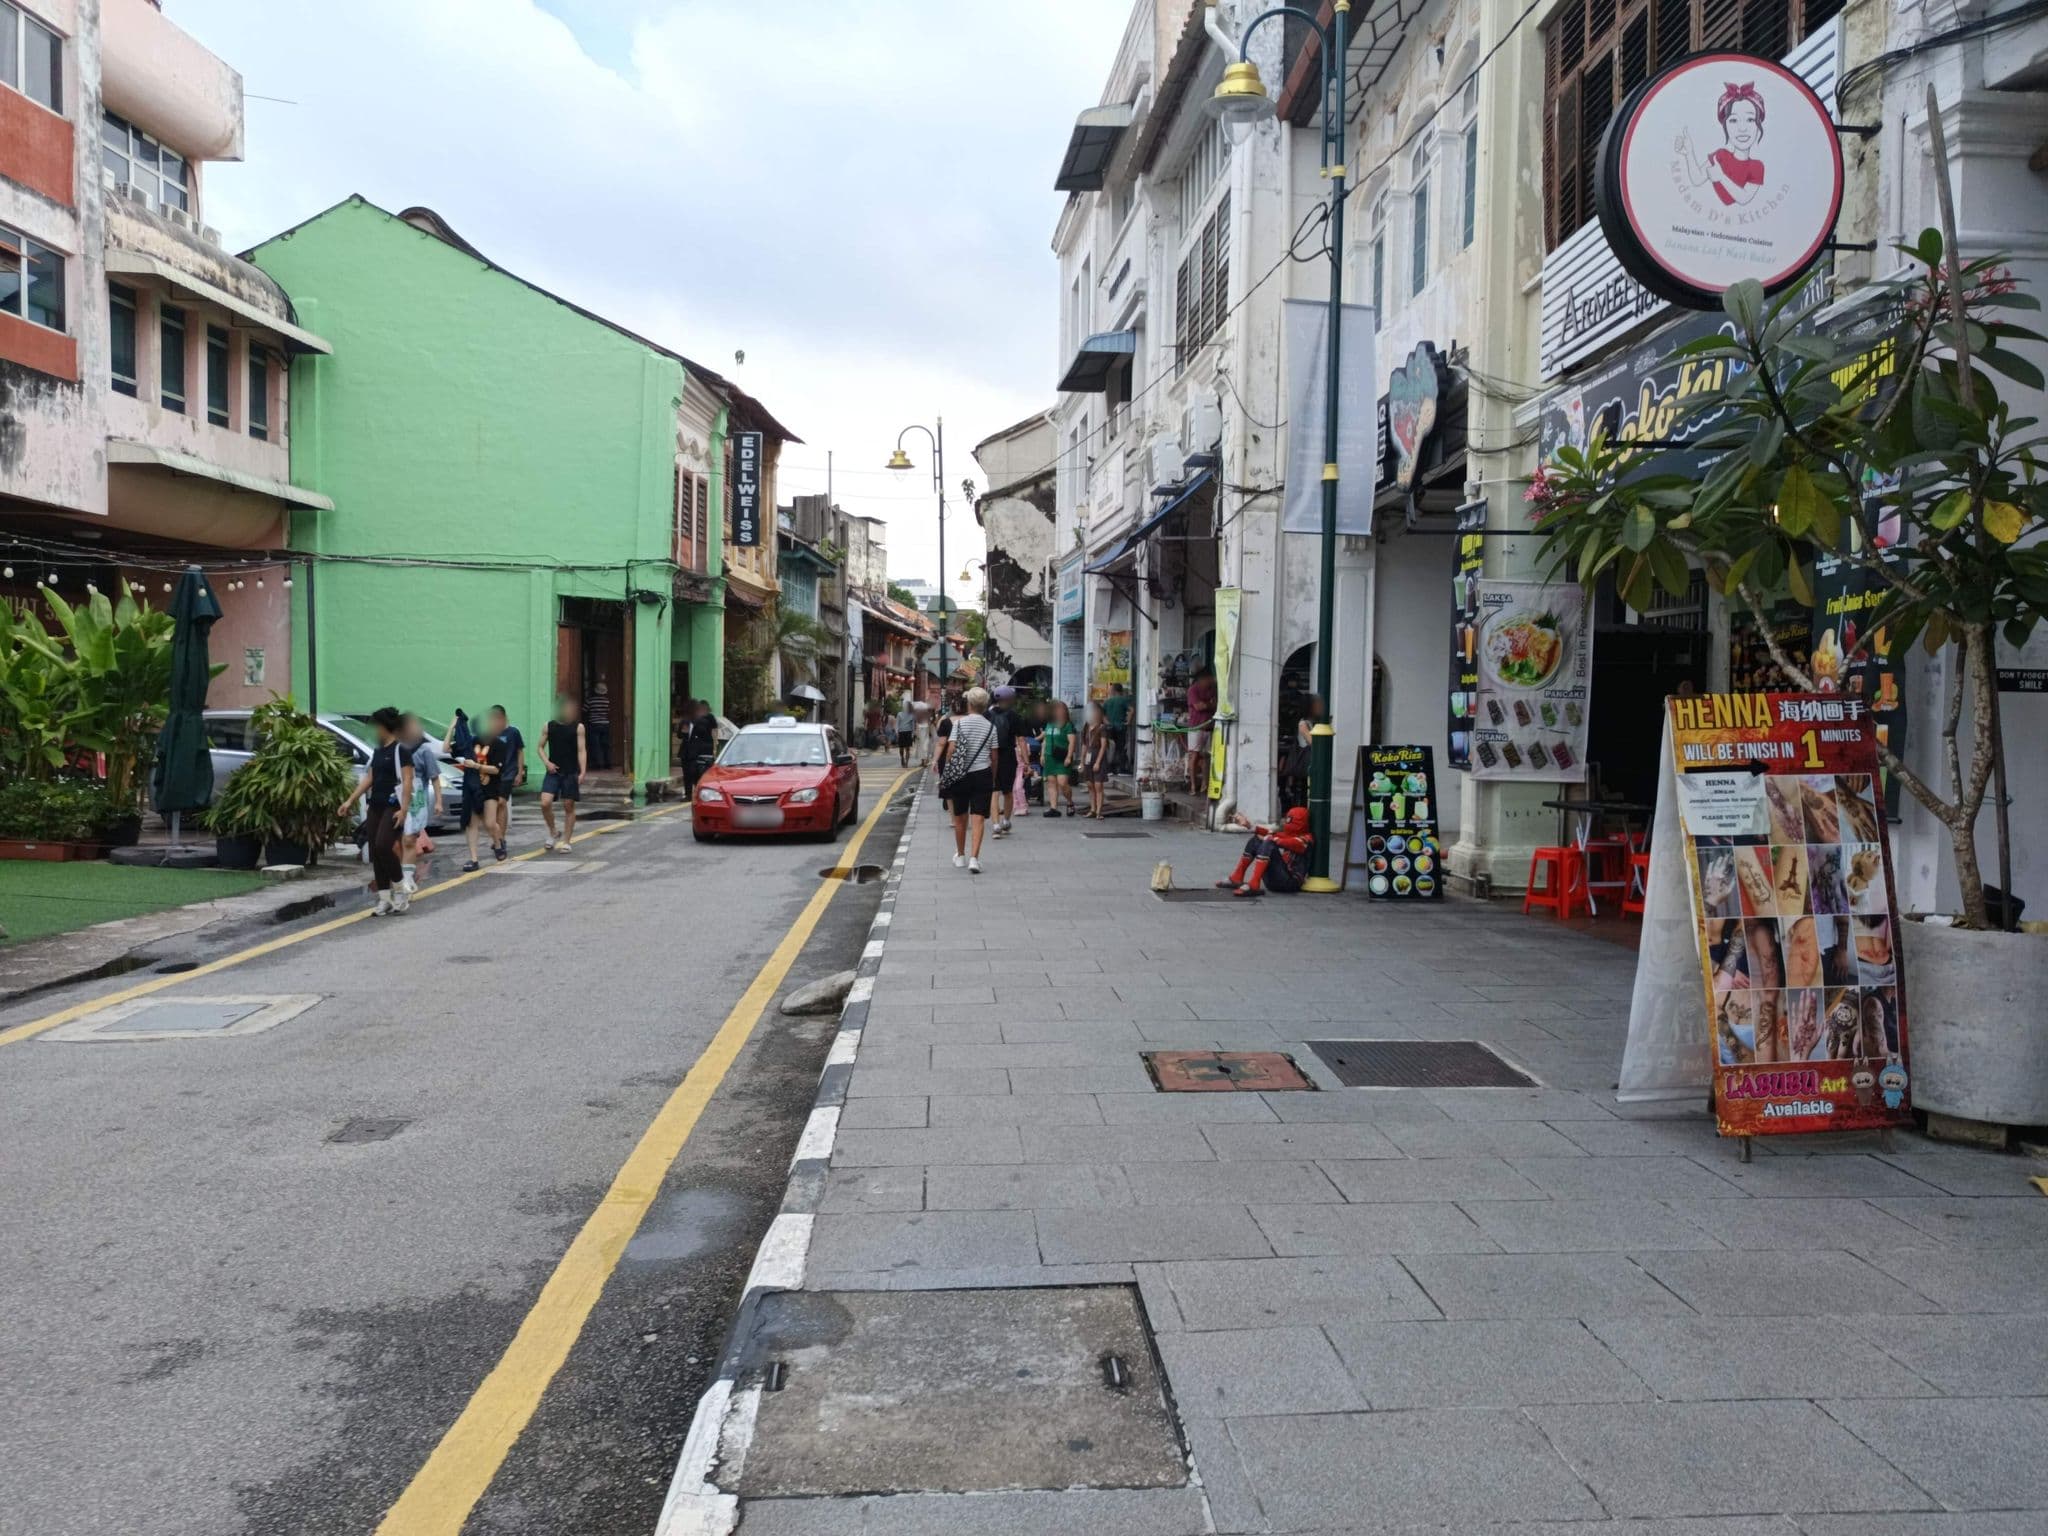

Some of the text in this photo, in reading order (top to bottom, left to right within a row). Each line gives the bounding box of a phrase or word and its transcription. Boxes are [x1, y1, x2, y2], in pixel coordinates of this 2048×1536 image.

[1738, 183, 1790, 225] Kitchen
[738, 436, 756, 542] EDELWEISS
[1483, 594, 1513, 602] LAKSA
[1545, 690, 1585, 699] PANCAKE
[2018, 680, 2042, 689] SMILE
[1675, 693, 1774, 730] HENNA
[1778, 700, 1868, 722] 海纳画手
[1683, 728, 1862, 769] WILL BE FINISH IN 1 MINUTES
[1705, 779, 1736, 787] HENNA
[1724, 1070, 1819, 1100] LABUBU
[1763, 1100, 1834, 1117] Available
